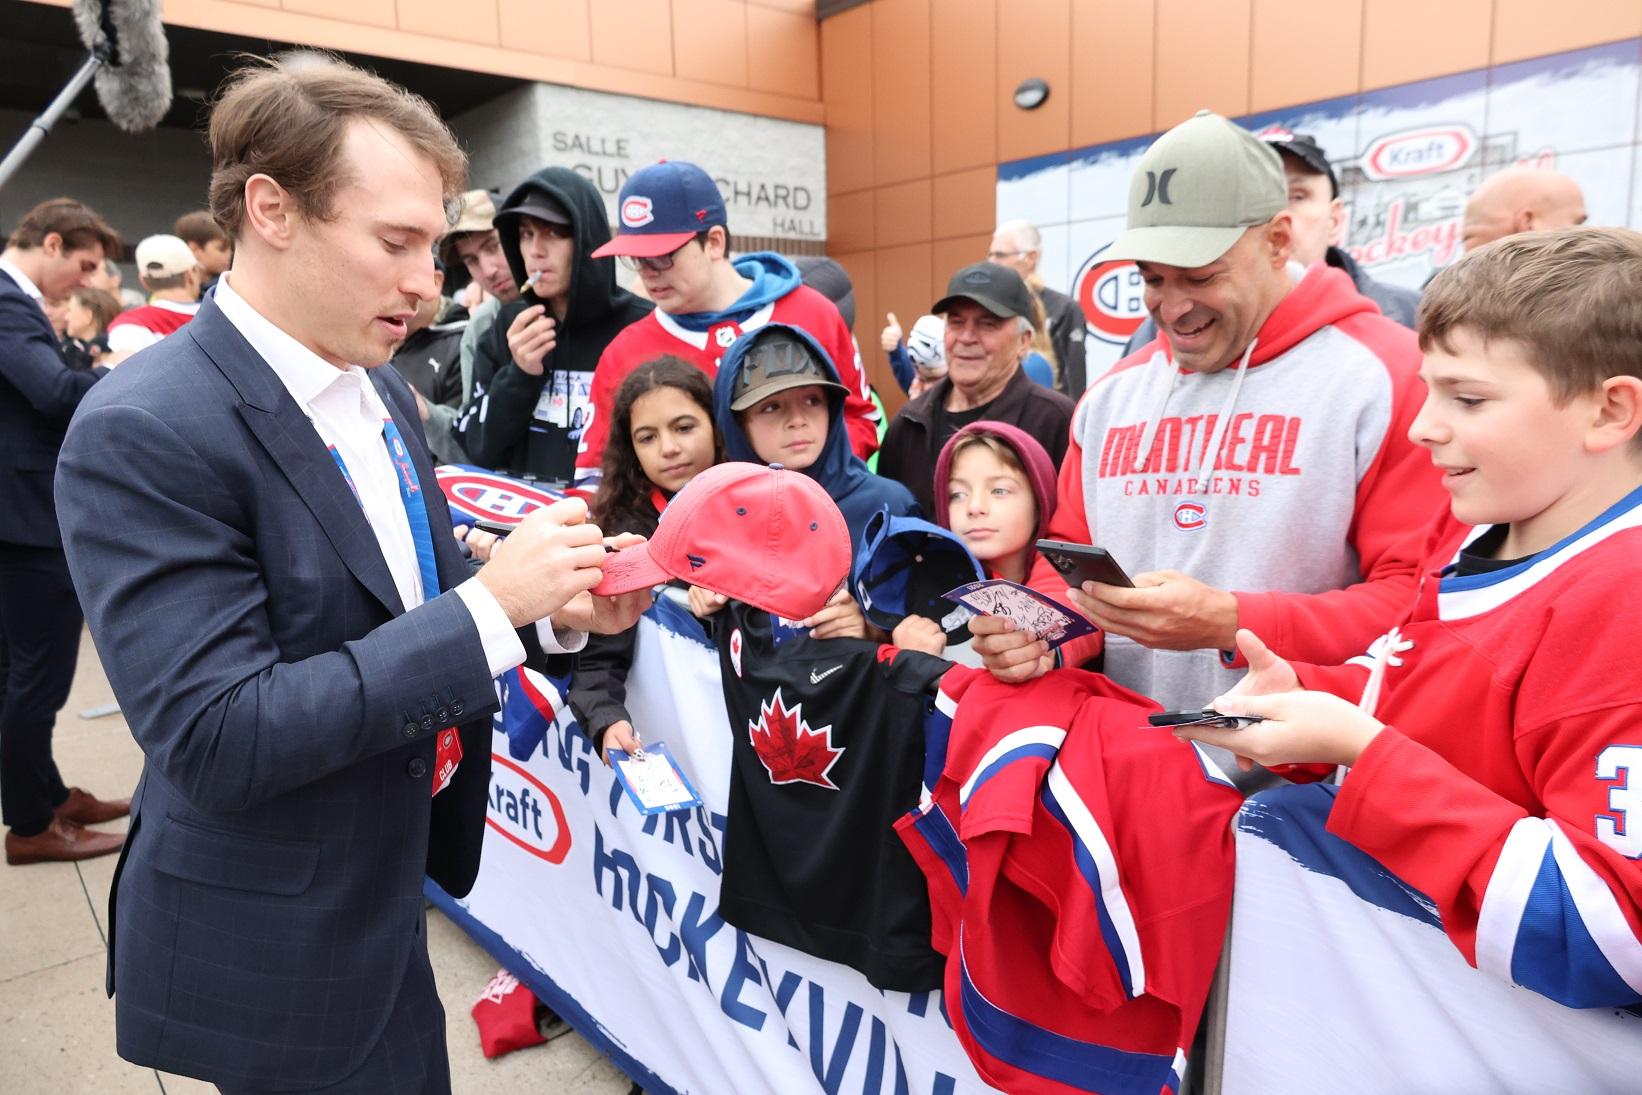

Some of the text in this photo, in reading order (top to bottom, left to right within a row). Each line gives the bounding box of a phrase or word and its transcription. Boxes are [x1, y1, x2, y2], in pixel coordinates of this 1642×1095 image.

[552, 131, 630, 158] SALLE
[1389, 140, 1445, 166] Kraft
[772, 217, 820, 236] HALL
[1124, 477, 1261, 497] CANADENS
[439, 760, 453, 781] CLUB
